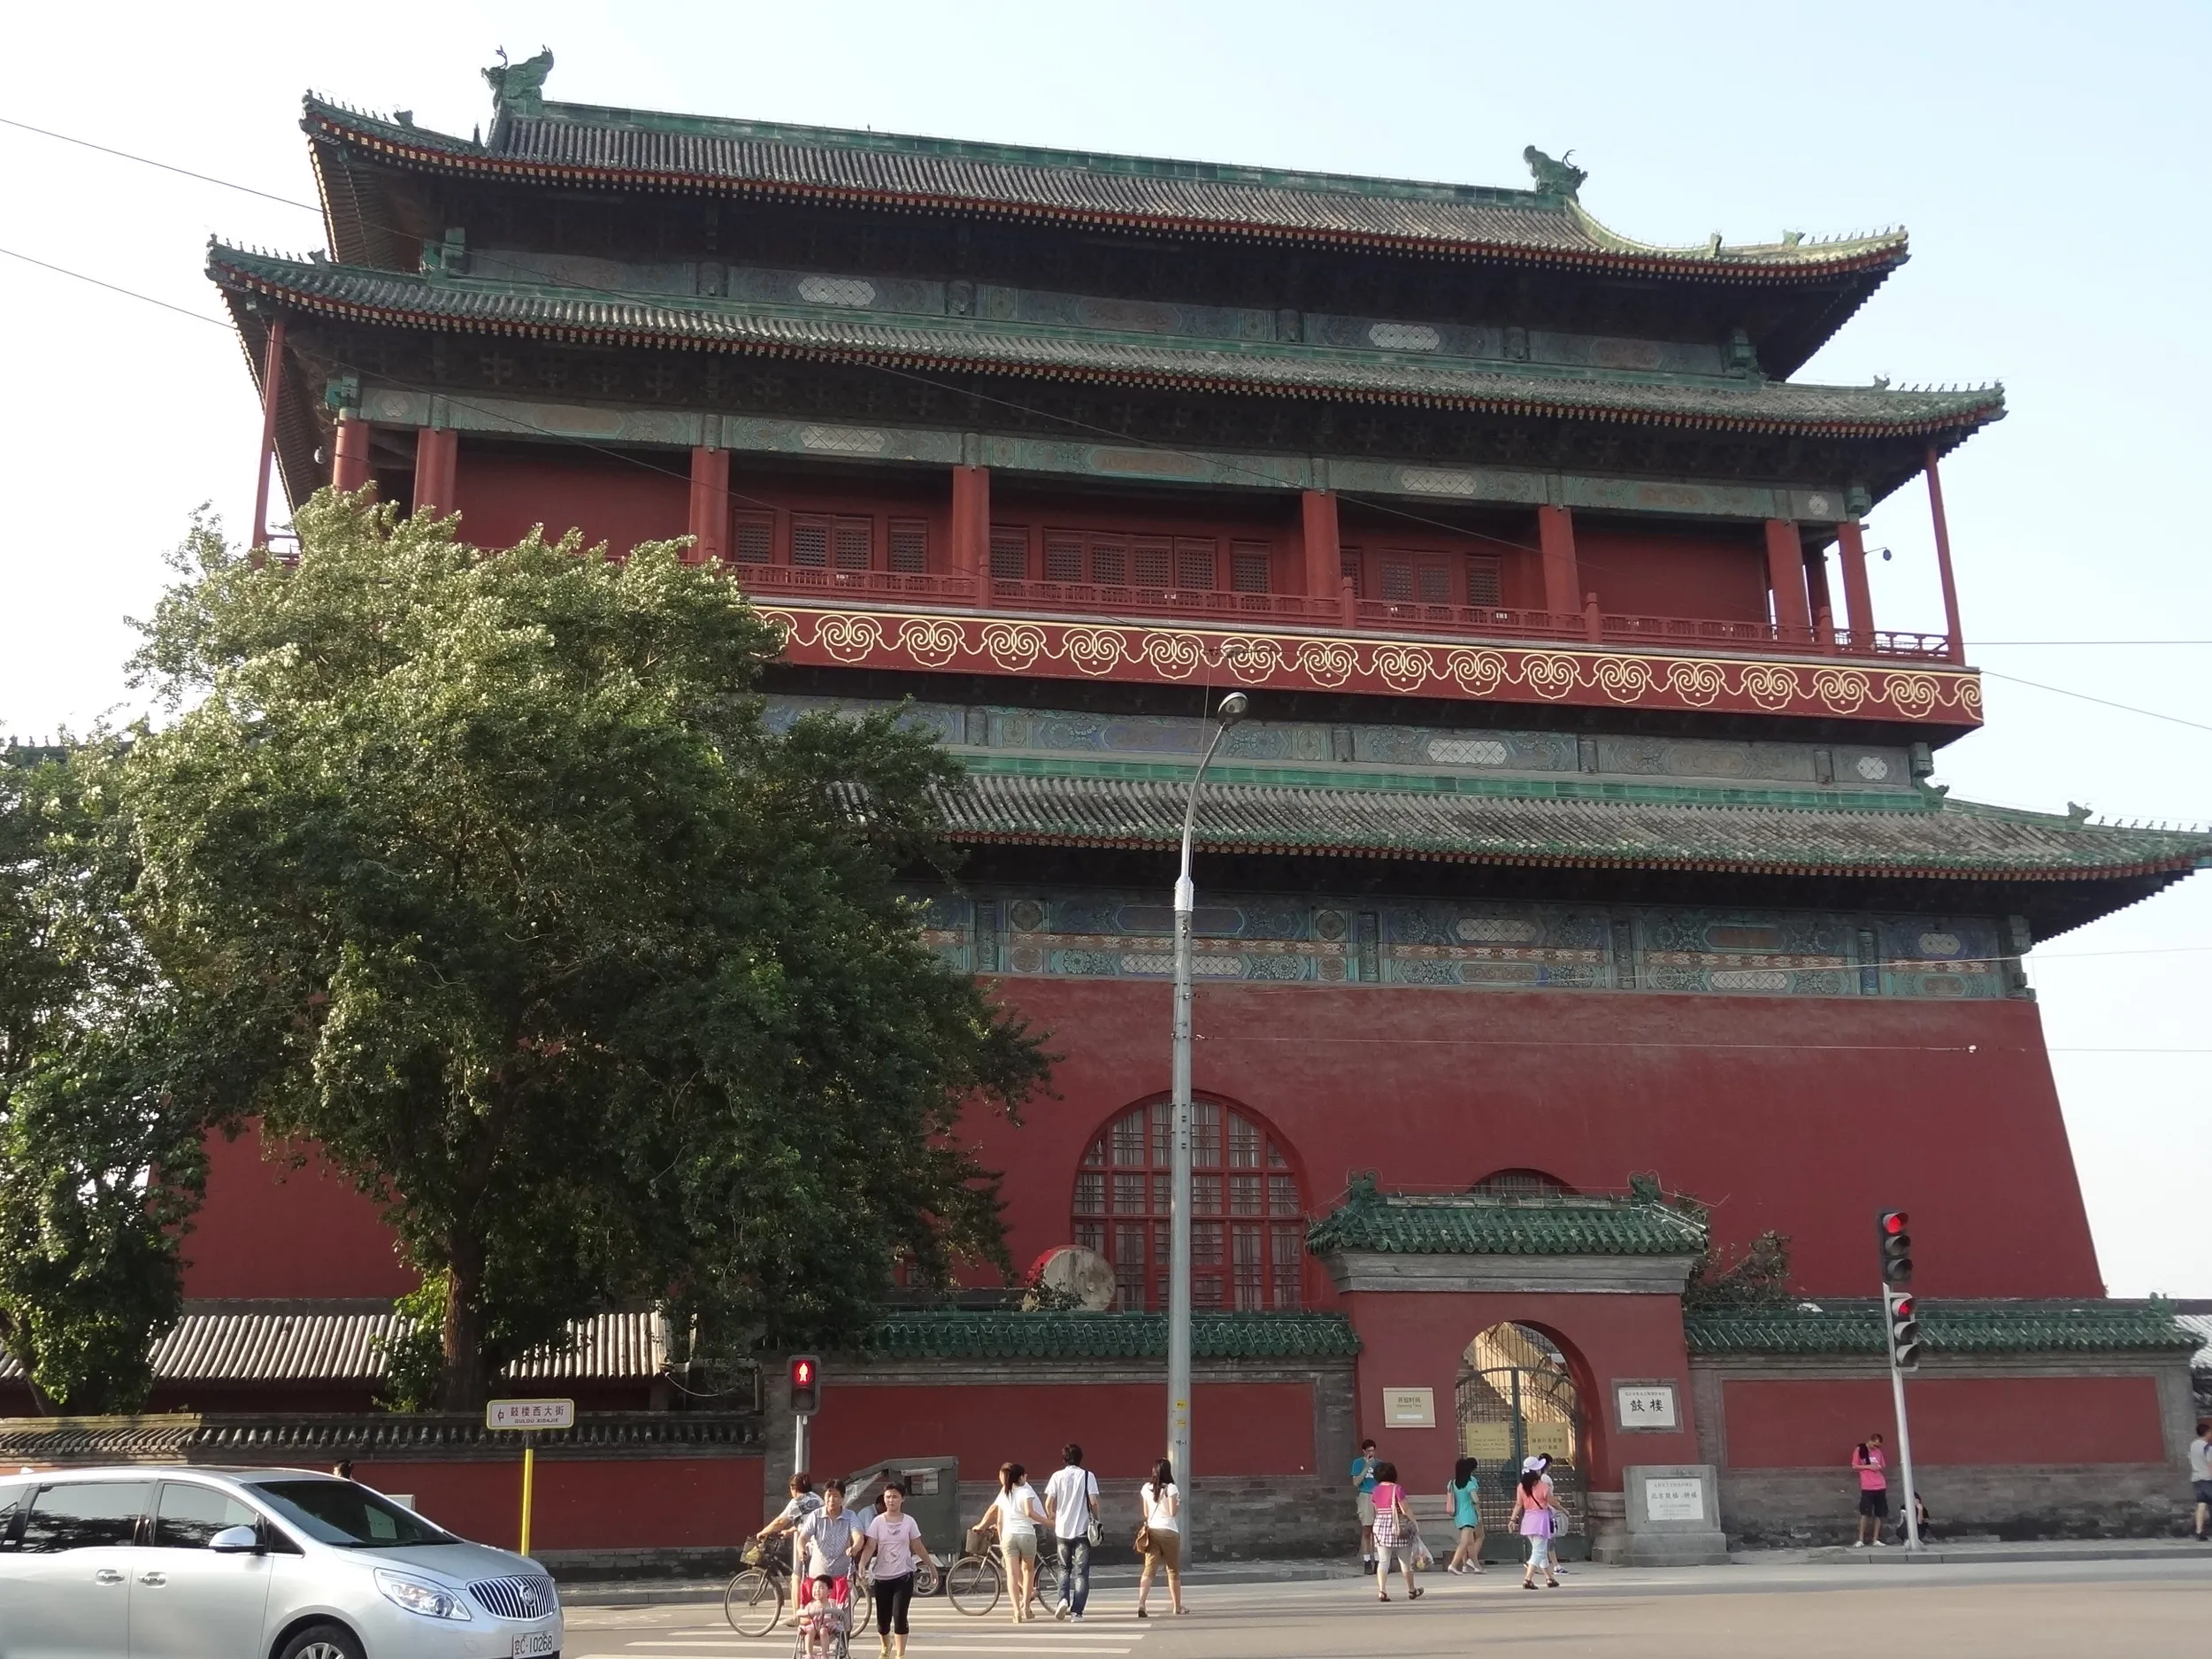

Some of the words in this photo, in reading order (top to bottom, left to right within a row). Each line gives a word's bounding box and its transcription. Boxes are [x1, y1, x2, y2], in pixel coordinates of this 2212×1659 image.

[510, 1405, 565, 1417] 鼓楼西大街
[1630, 1399, 1663, 1412] 鼓楼
